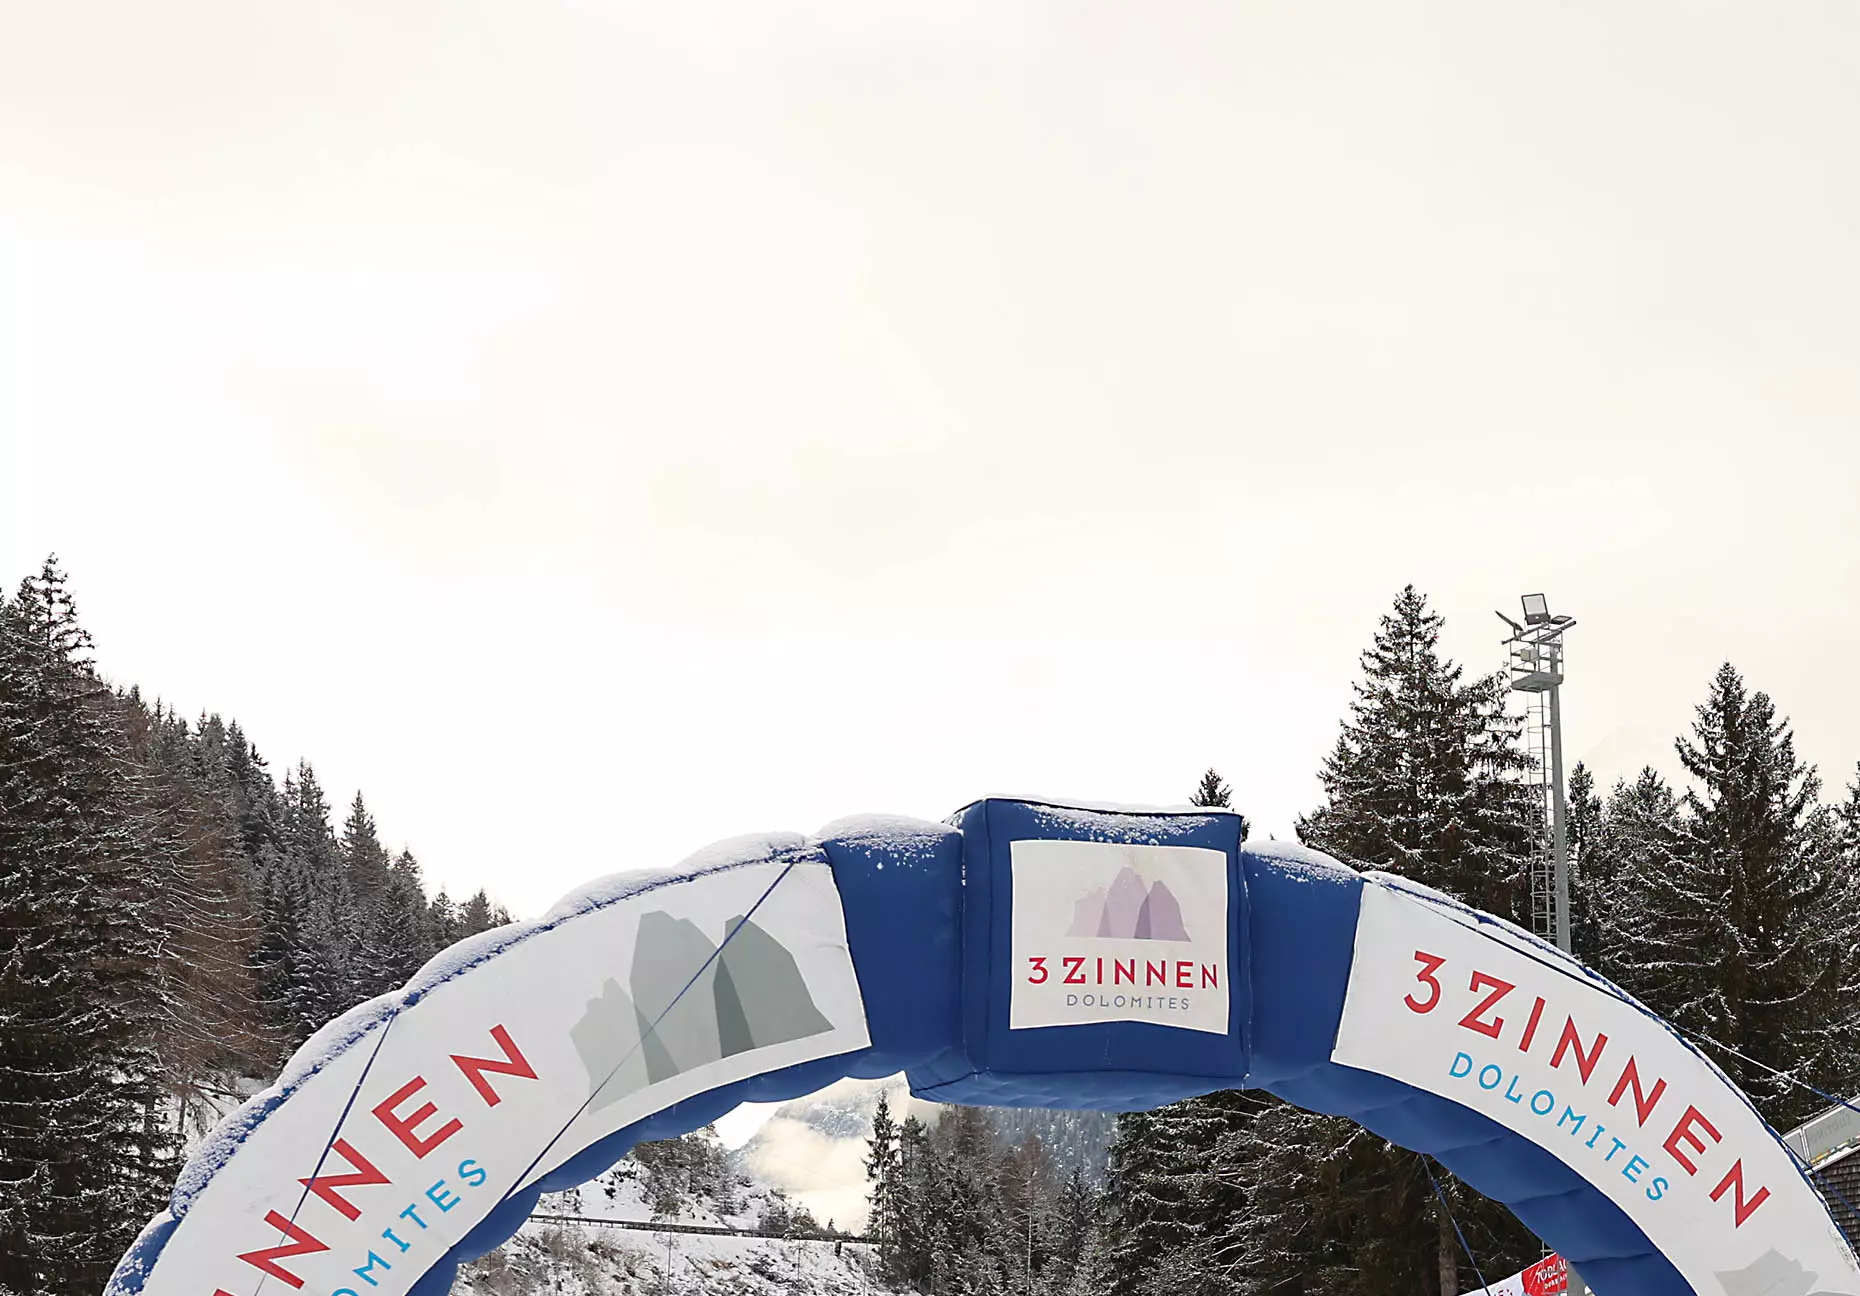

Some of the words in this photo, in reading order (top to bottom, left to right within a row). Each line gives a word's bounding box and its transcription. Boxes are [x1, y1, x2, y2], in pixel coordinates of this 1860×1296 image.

[1027, 956, 1049, 985] 3
[1062, 956, 1219, 989] ZINNEN
[1066, 993, 1190, 1011] DOLOMITES
[1403, 950, 1447, 1015] 3
[1458, 970, 1772, 1230] ZINNEN
[1448, 1050, 1671, 1202] DOLOMITES
